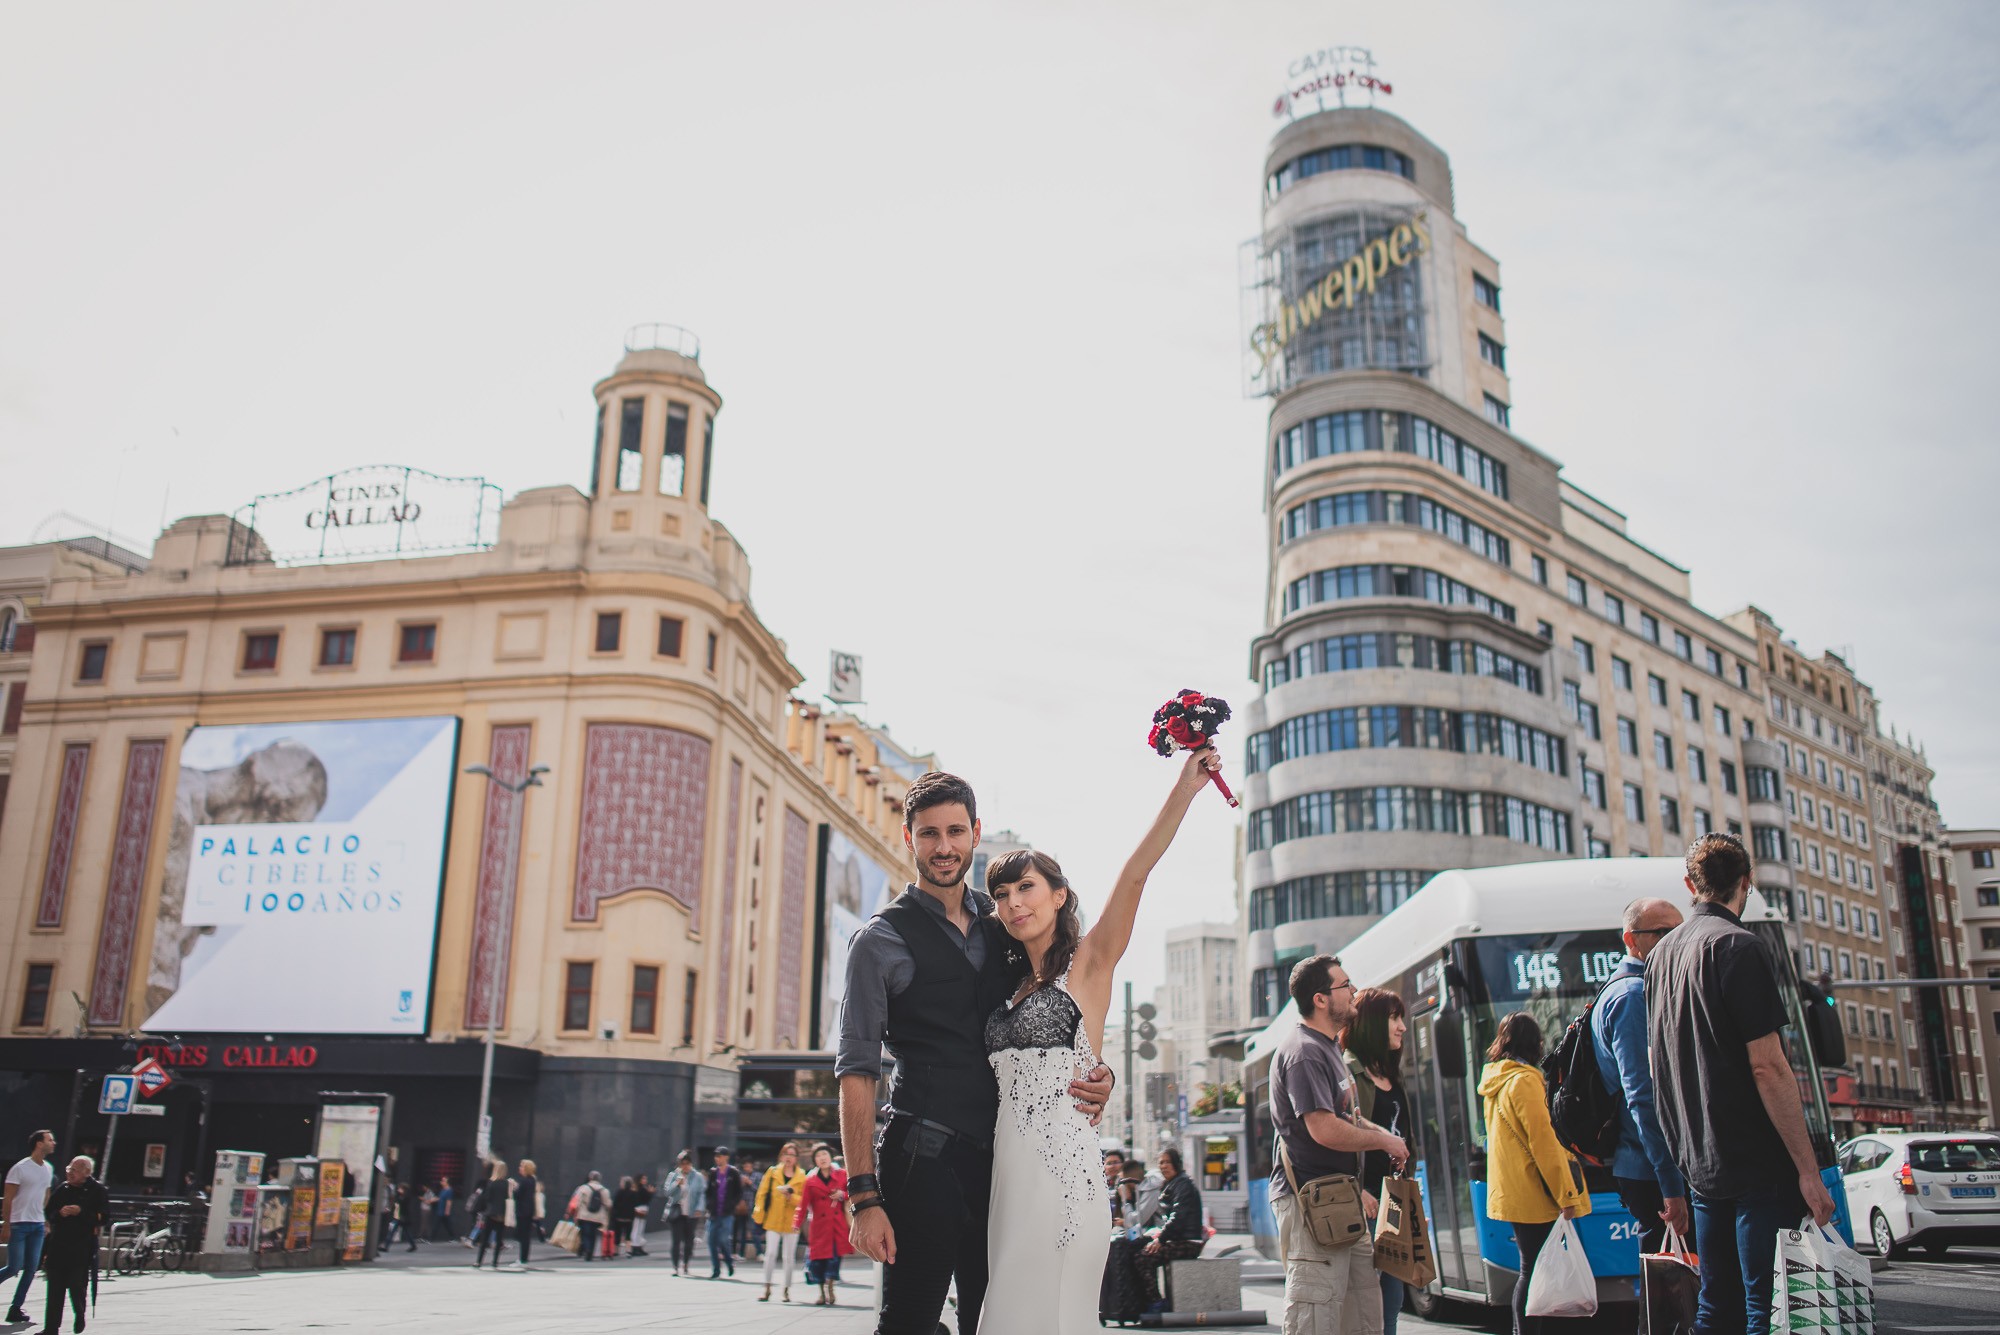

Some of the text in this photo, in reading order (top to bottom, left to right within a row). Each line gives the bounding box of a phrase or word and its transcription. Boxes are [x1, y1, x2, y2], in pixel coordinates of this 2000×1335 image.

[330, 484, 401, 502] CINES
[305, 503, 421, 529] CALLAO
[201, 835, 361, 857] PALACIO
[217, 862, 382, 886] CIBELES
[1513, 952, 1561, 991] 146
[136, 1045, 317, 1068] CINES CALLAO
